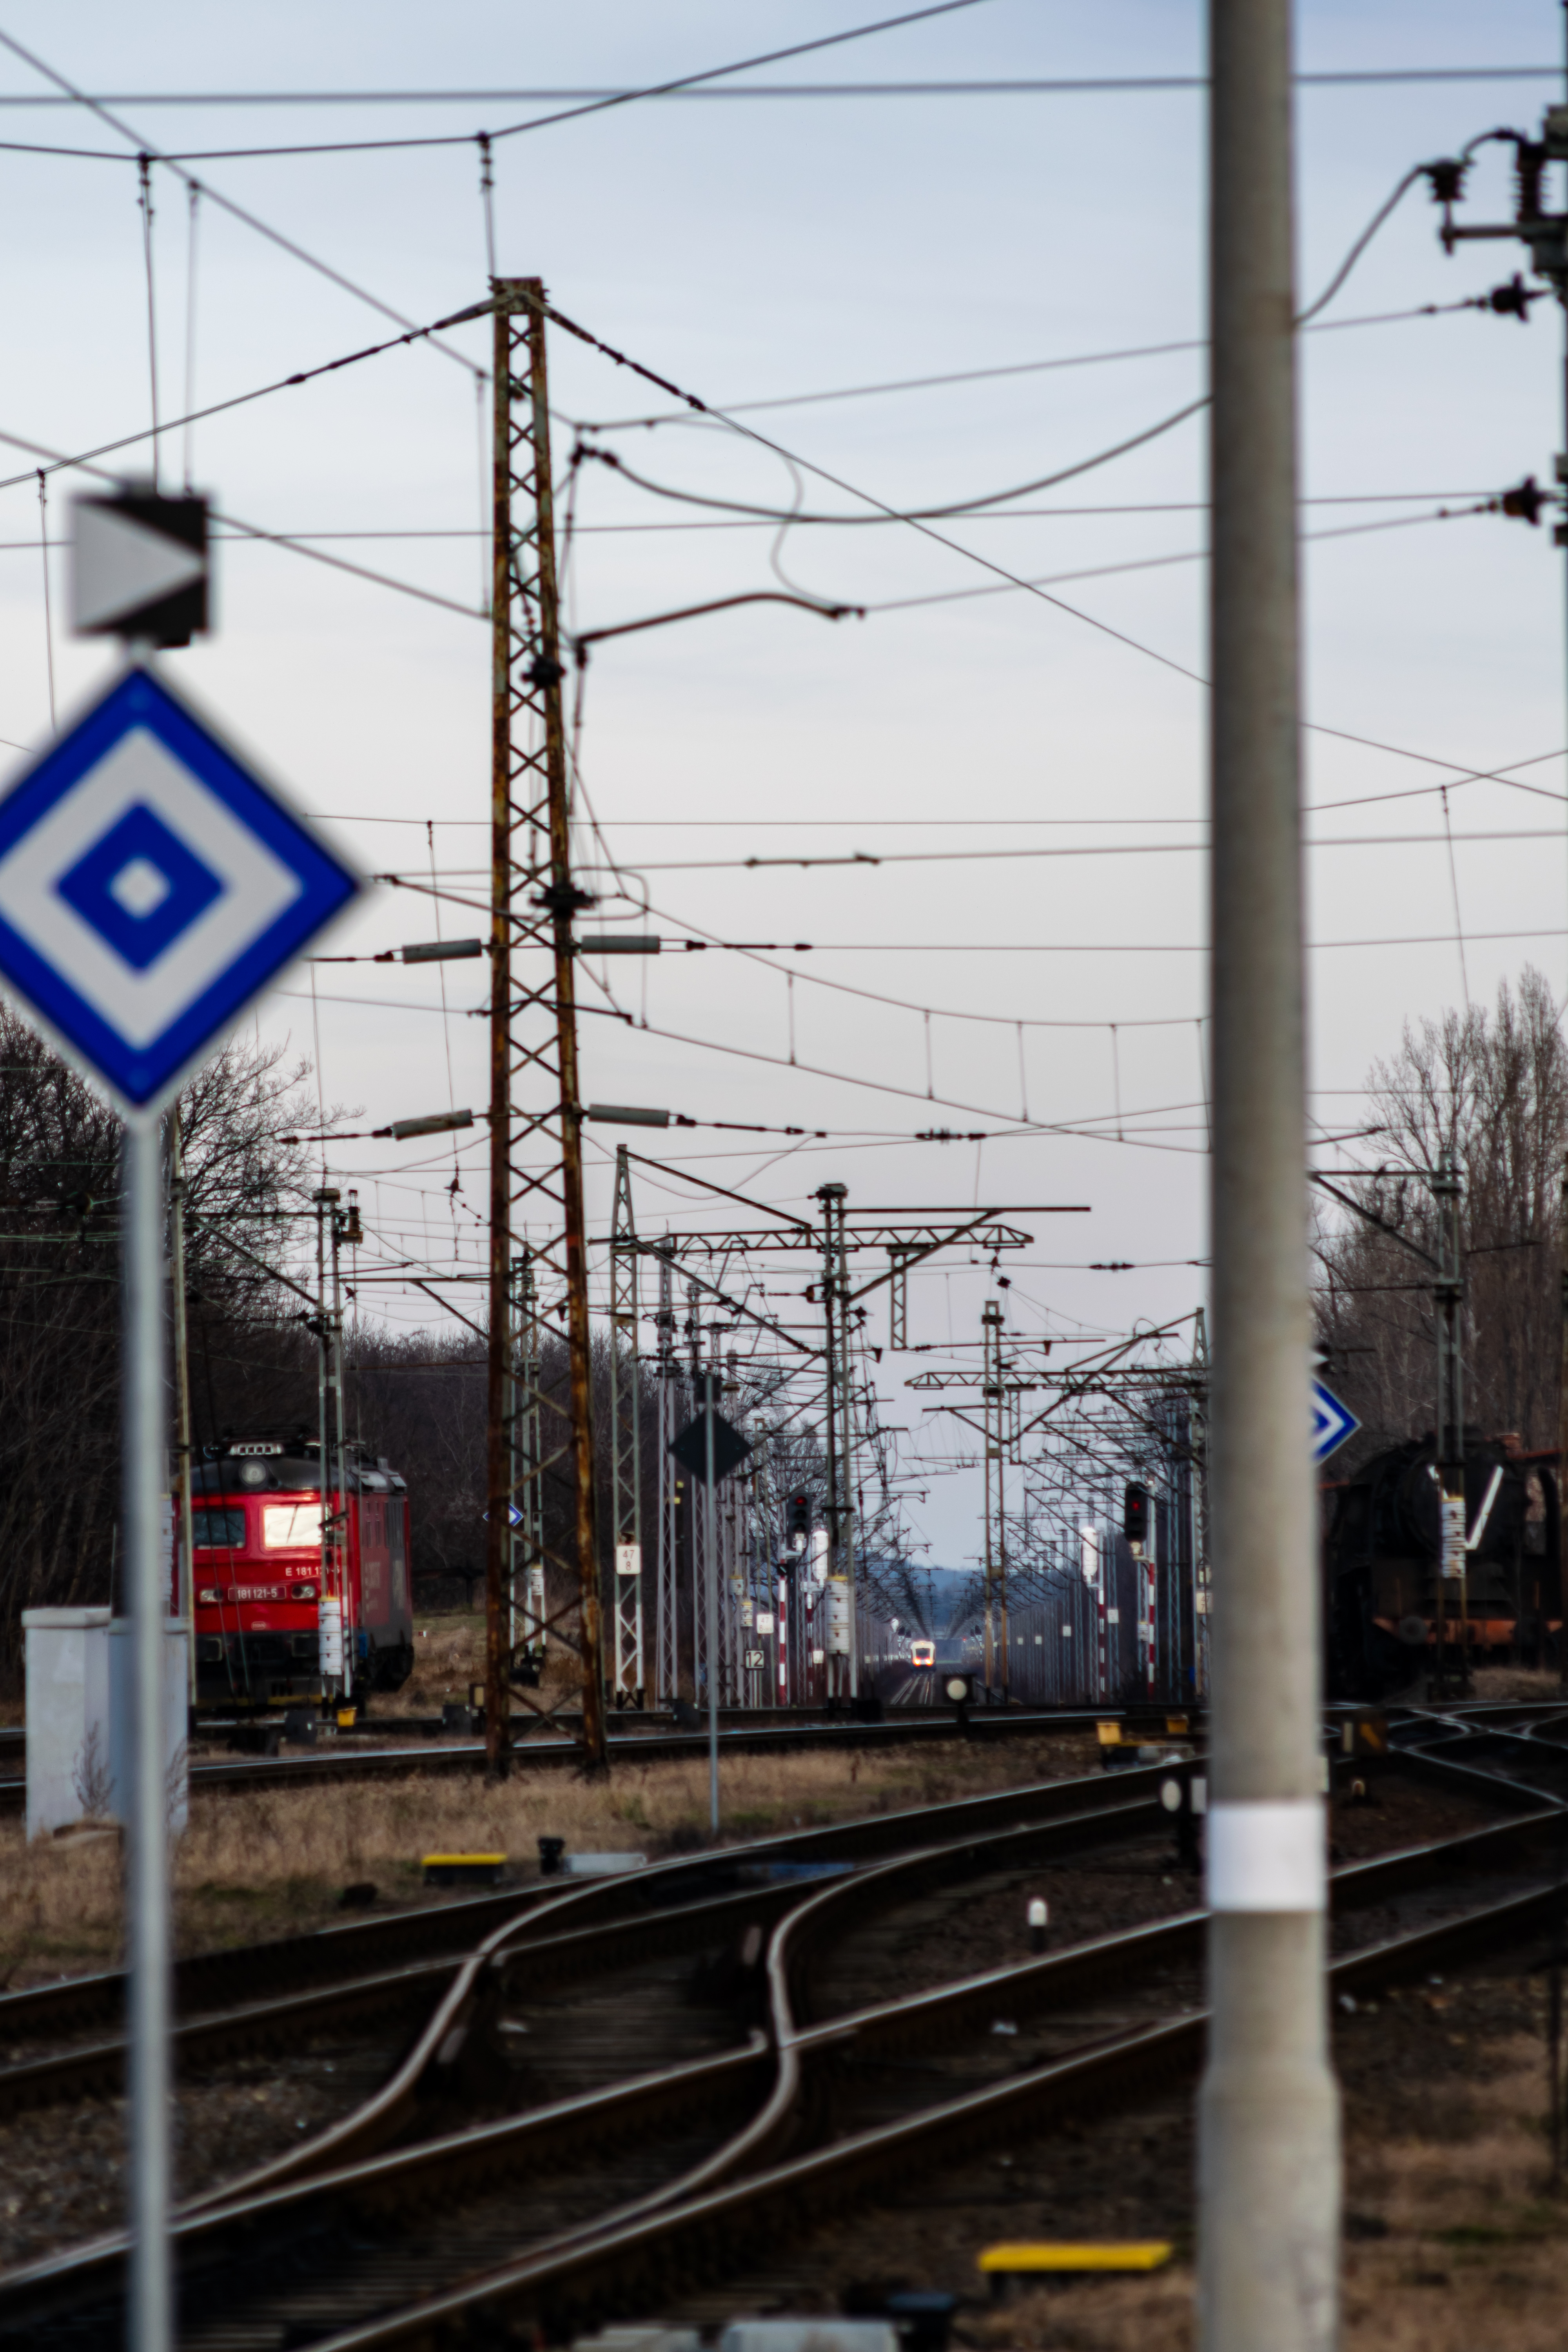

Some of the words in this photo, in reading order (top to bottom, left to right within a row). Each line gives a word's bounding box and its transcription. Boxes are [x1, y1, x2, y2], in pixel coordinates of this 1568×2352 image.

[622, 1550, 634, 1559] 47
[626, 1561, 631, 1571] 8
[285, 1568, 292, 1576] E
[296, 1567, 312, 1576] 181
[238, 1589, 250, 1599] 181
[253, 1588, 277, 1599] 121-5
[746, 1651, 763, 1667] 12
